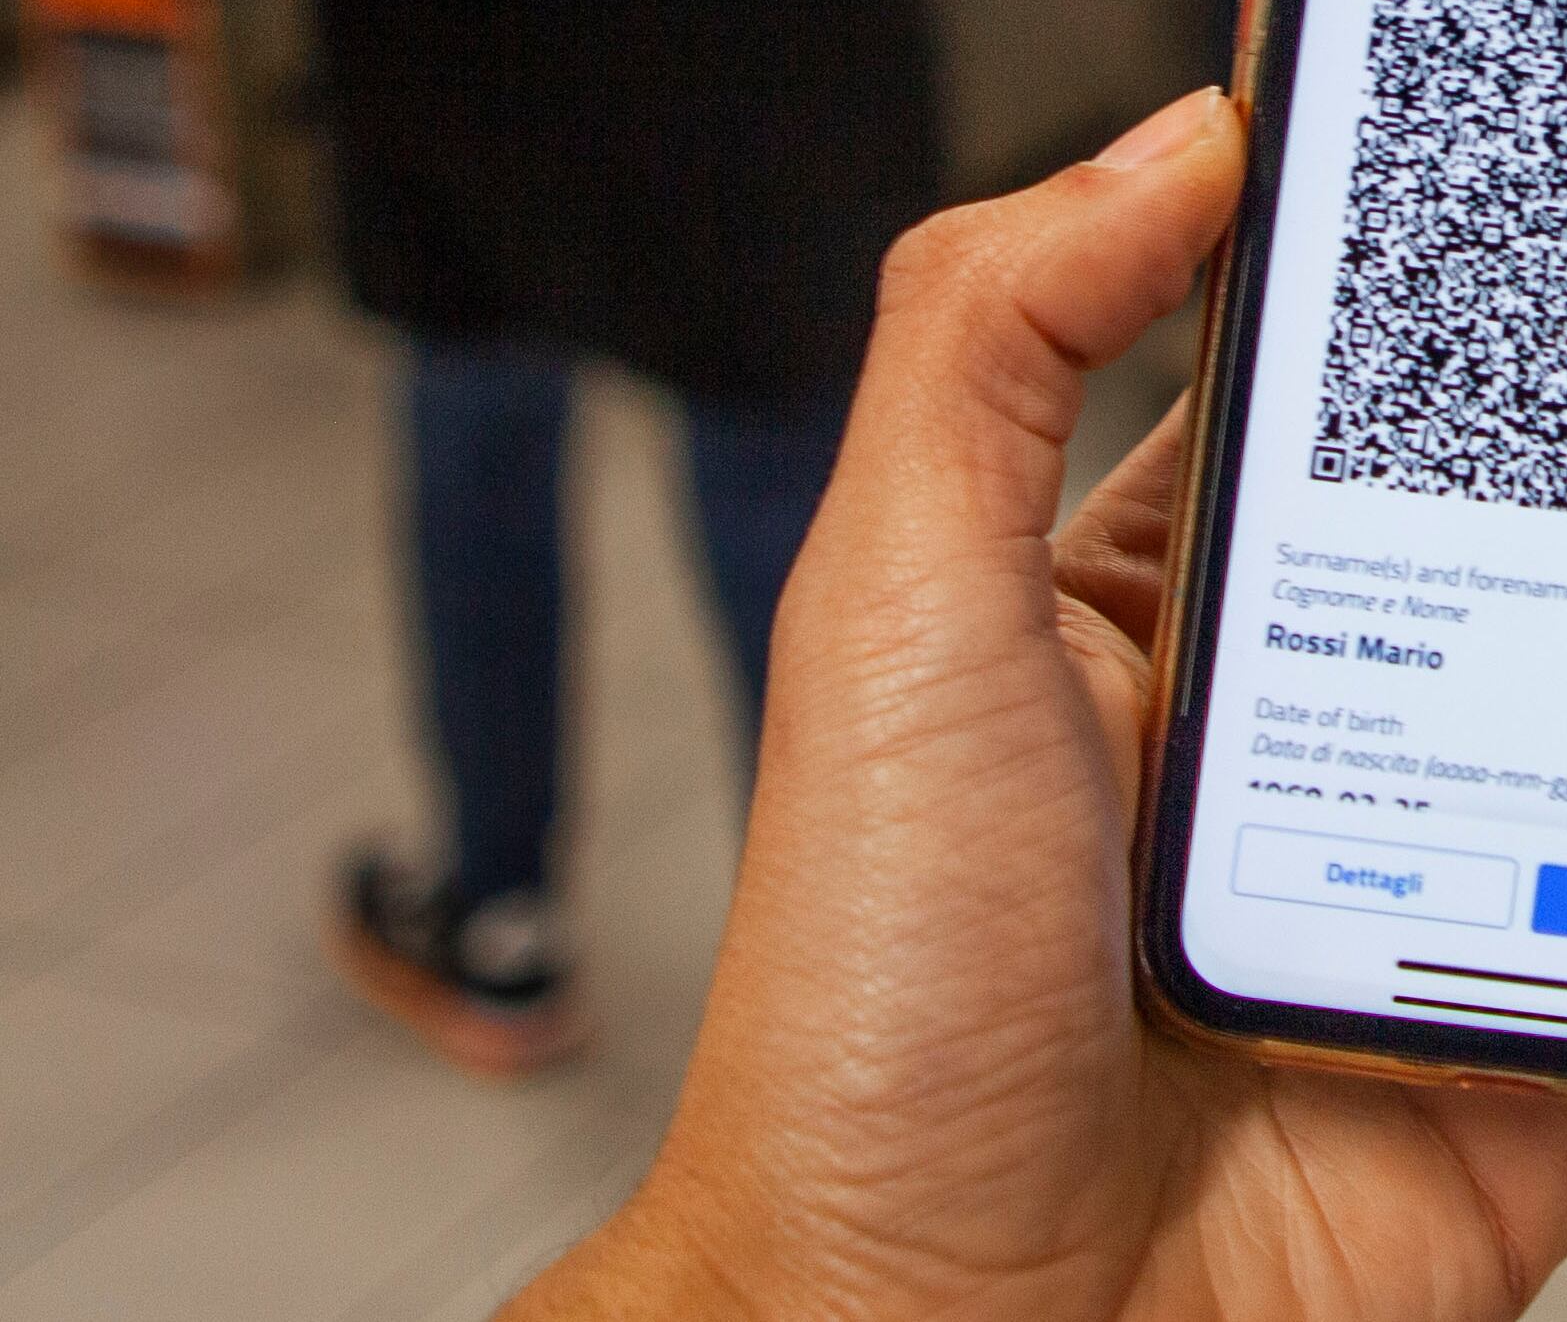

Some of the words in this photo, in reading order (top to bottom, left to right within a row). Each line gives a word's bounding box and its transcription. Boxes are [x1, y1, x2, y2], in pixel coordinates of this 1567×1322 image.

[1276, 541, 1413, 583] Surname(s)
[1416, 564, 1462, 589] and
[1272, 579, 1375, 613] Cognome
[1382, 596, 1397, 616] e
[1401, 595, 1470, 625] Nome
[1265, 623, 1349, 659] Rossi
[1355, 634, 1445, 671] Mario
[1254, 696, 1312, 727] Date
[1316, 706, 1344, 731] of
[1347, 708, 1406, 738] birth
[1250, 732, 1307, 761] Data
[1311, 741, 1333, 764] di
[1337, 749, 1421, 777] nascita
[1325, 862, 1425, 899] Dettagli
